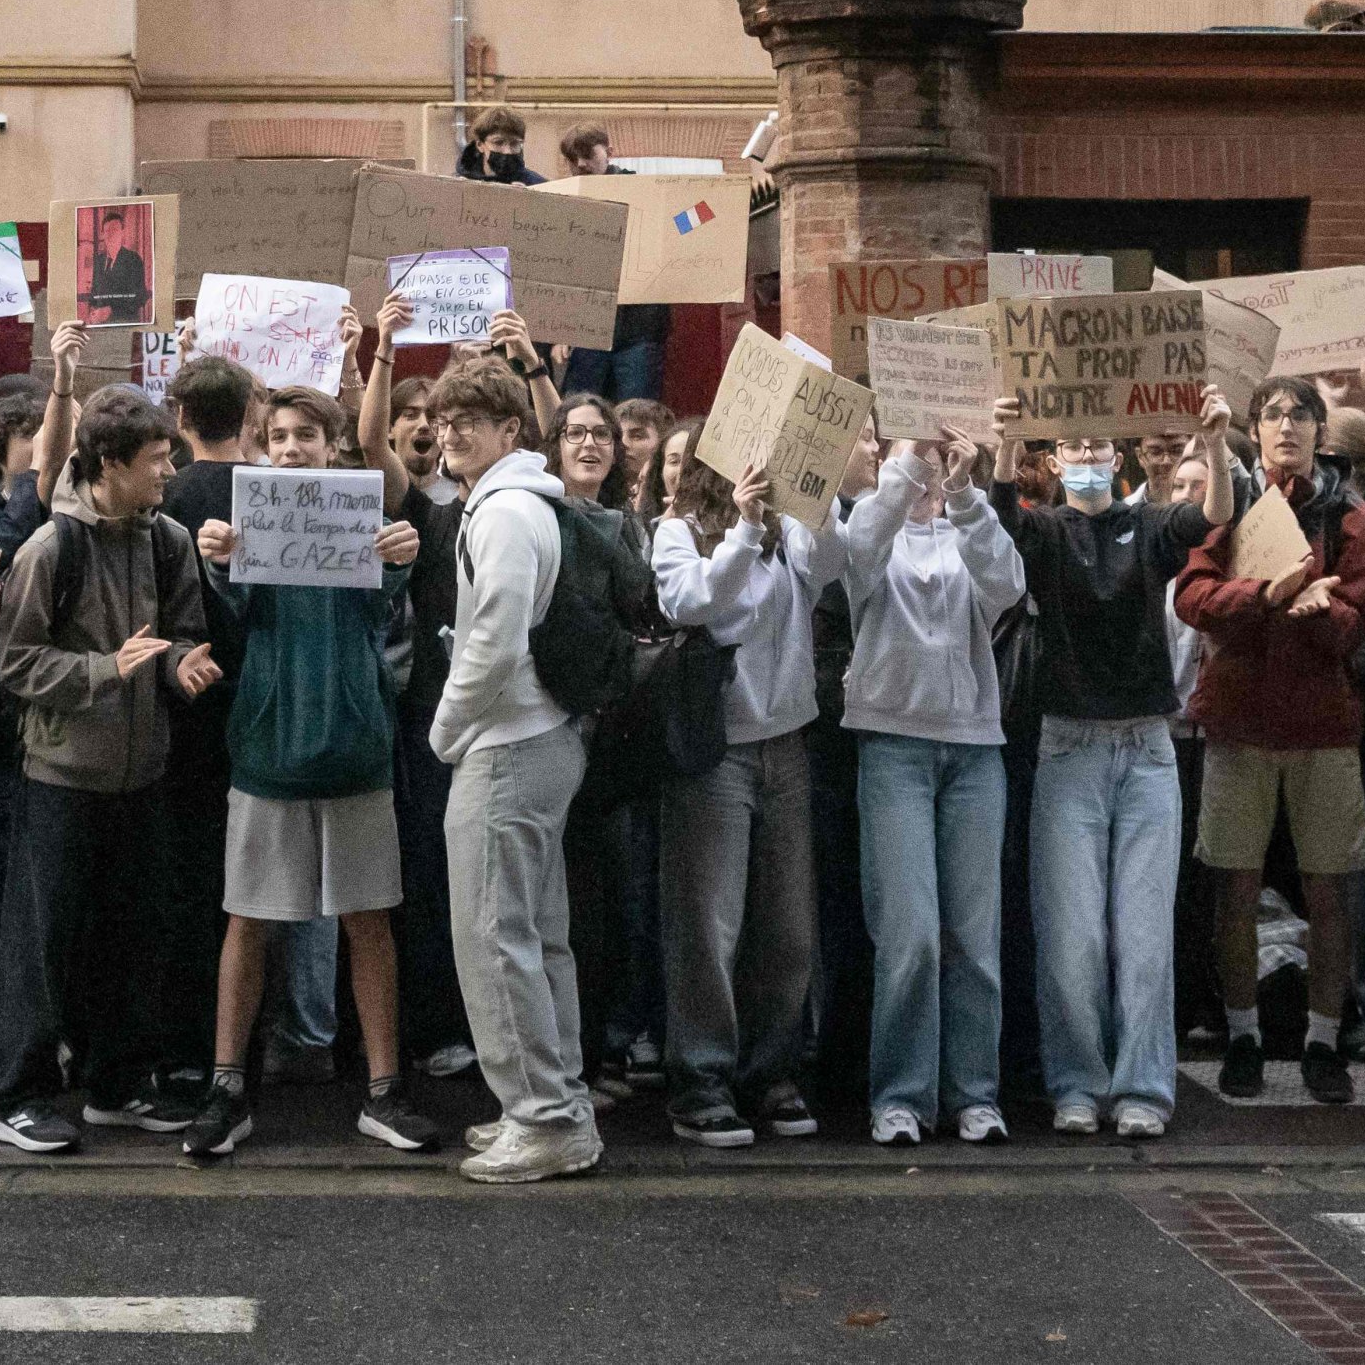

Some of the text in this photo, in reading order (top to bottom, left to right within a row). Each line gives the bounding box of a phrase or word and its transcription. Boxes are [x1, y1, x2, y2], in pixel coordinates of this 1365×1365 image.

[458, 192, 499, 229] lives
[513, 207, 559, 241] begin
[369, 224, 398, 248] the
[512, 249, 575, 268] ecome
[419, 274, 453, 286] PASSE
[473, 273, 491, 285] DE
[836, 263, 926, 315] NOS
[209, 312, 254, 333] PAS
[223, 282, 319, 325] ON EST
[468, 299, 484, 311] EN
[1003, 303, 1135, 348] MACRON
[1009, 350, 1061, 379] TA
[1075, 347, 1147, 380] PROF
[1164, 337, 1207, 376] PAS
[736, 387, 757, 412] ON
[1016, 382, 1115, 420] NOTRE
[303, 513, 348, 542] temps
[279, 540, 374, 572] GAZER
